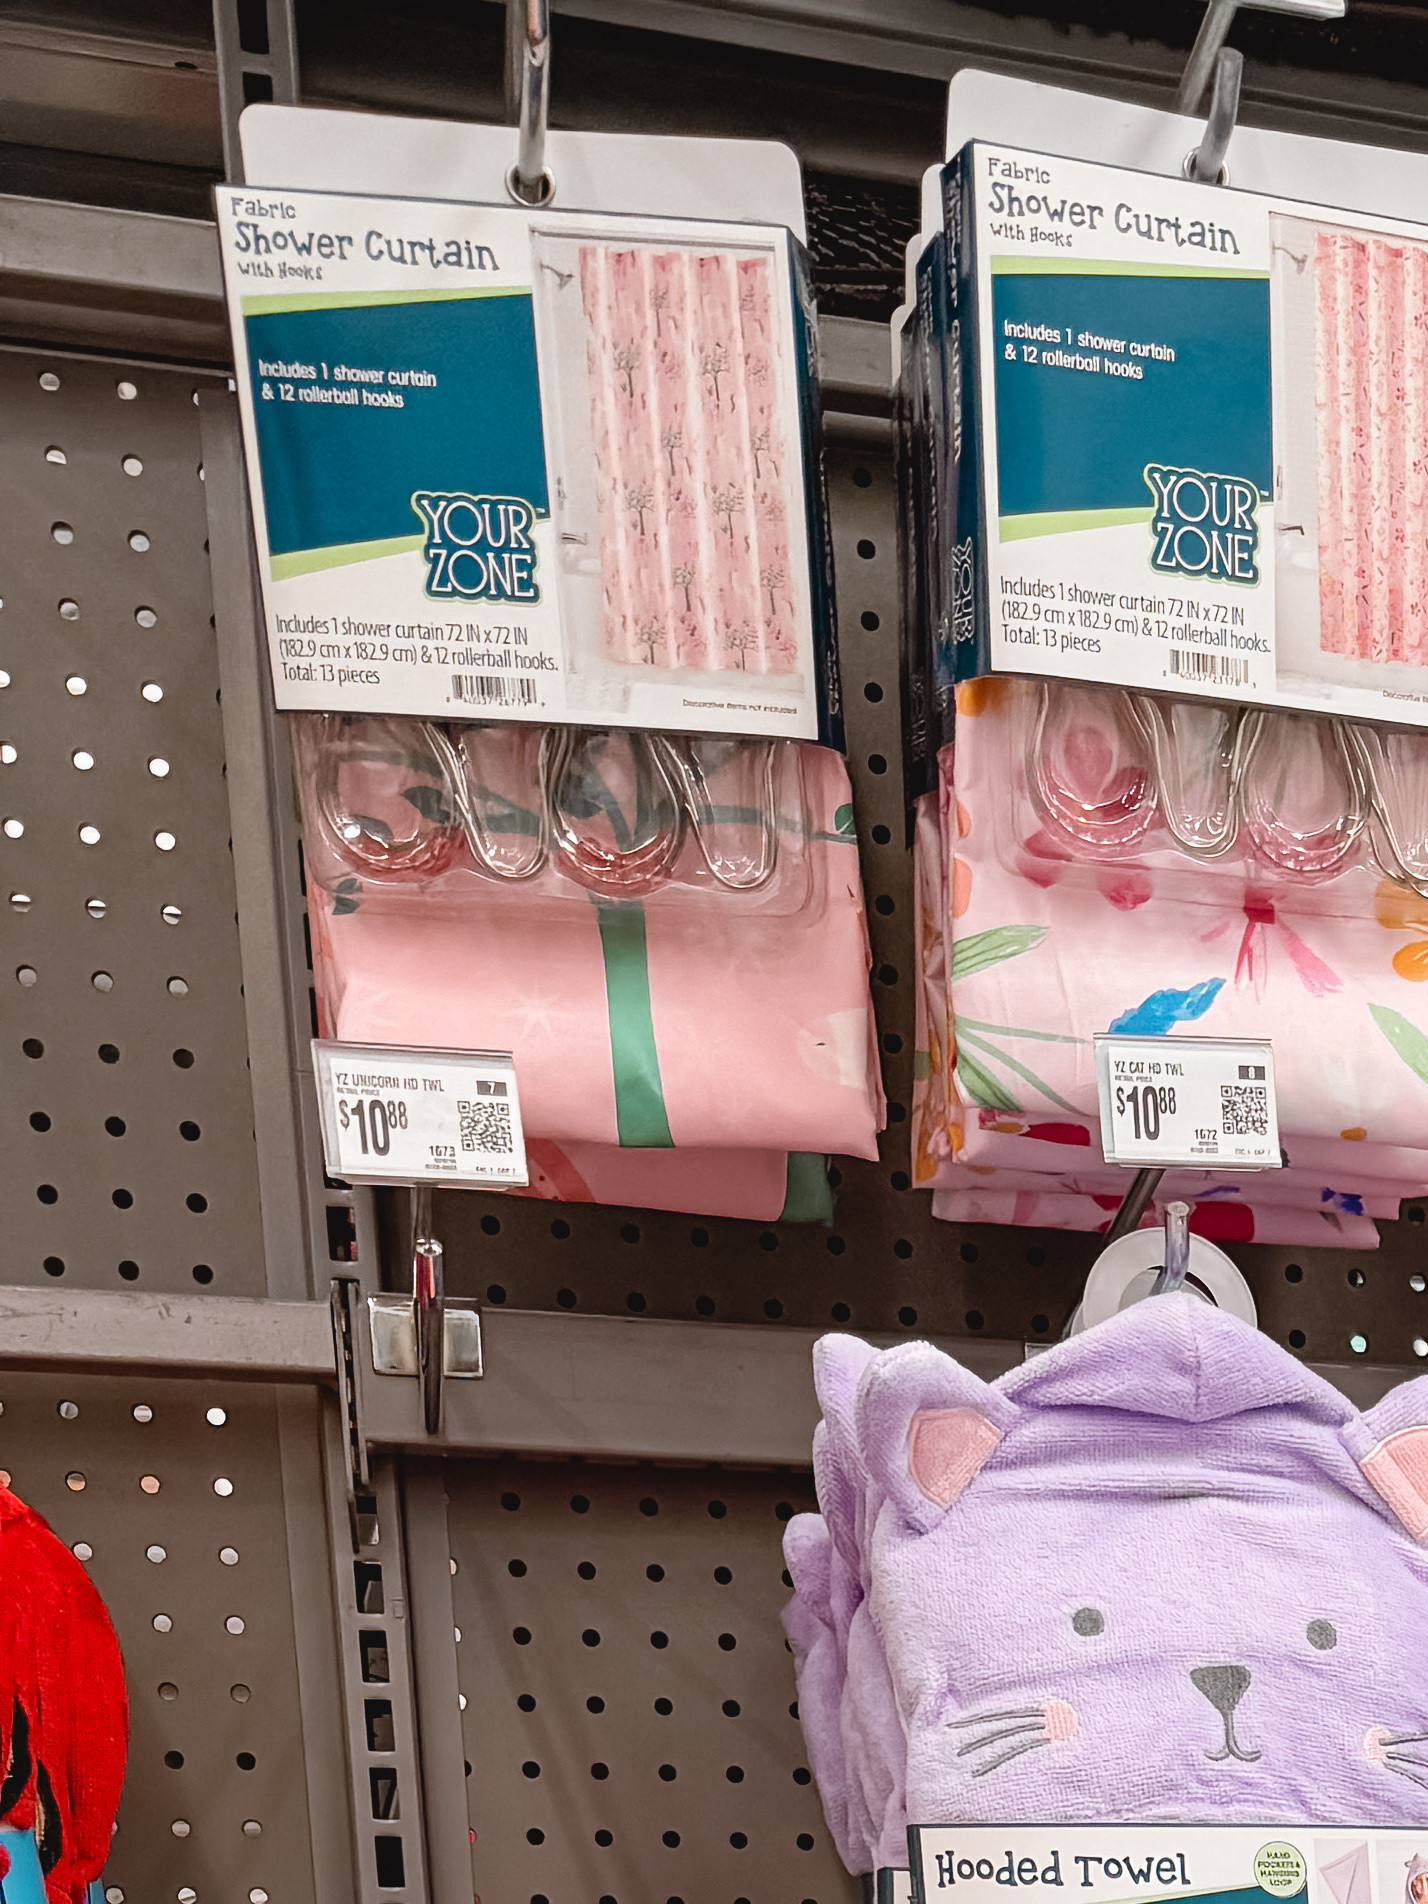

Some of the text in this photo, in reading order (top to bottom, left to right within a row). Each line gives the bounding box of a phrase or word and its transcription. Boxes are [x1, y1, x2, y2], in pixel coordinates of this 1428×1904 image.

[988, 158, 1050, 184] Fabric
[230, 198, 296, 219] Fabric
[989, 183, 1241, 255] Shower Curtain
[234, 223, 501, 272] Shower Curtain
[420, 499, 529, 549] YOUR
[1153, 473, 1254, 530] YOUR
[429, 552, 535, 597] ZONE
[1156, 524, 1254, 579] ZONE
[1001, 576, 1244, 625] Includes 1 shower curtain 72 IN x 72 IN
[1002, 602, 1271, 652] (182.9 cm x 182.9 cm) & 12 rollerball hooks.
[1002, 623, 1101, 654] Total: 13 pieces
[336, 1072, 445, 1092] YZ UNICORN HD TWL
[937, 1851, 1191, 1888] Hooded Towel
